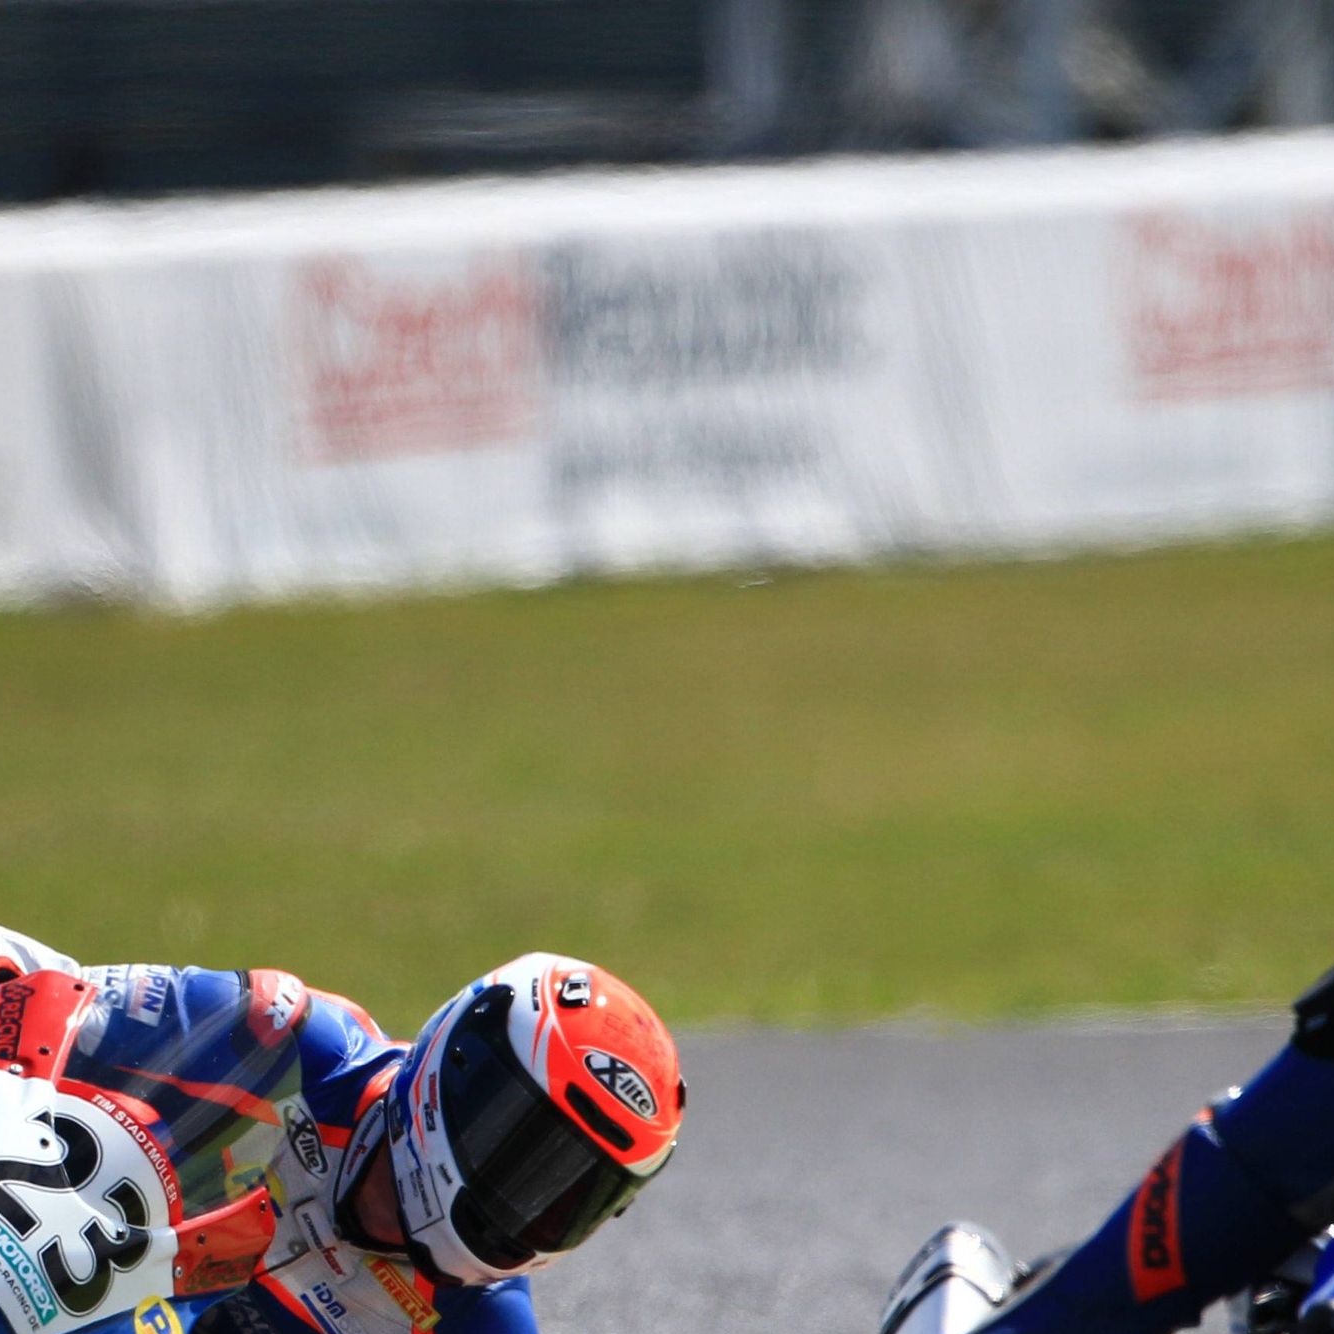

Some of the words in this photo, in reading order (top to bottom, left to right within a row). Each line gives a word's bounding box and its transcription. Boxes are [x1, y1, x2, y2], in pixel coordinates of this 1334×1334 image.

[586, 1050, 657, 1119] X-lite
[91, 1094, 116, 1117] TIM
[113, 1110, 178, 1205] STADTMÜLLER
[284, 1103, 320, 1169] X-lite
[370, 1258, 434, 1326] PIRELLI
